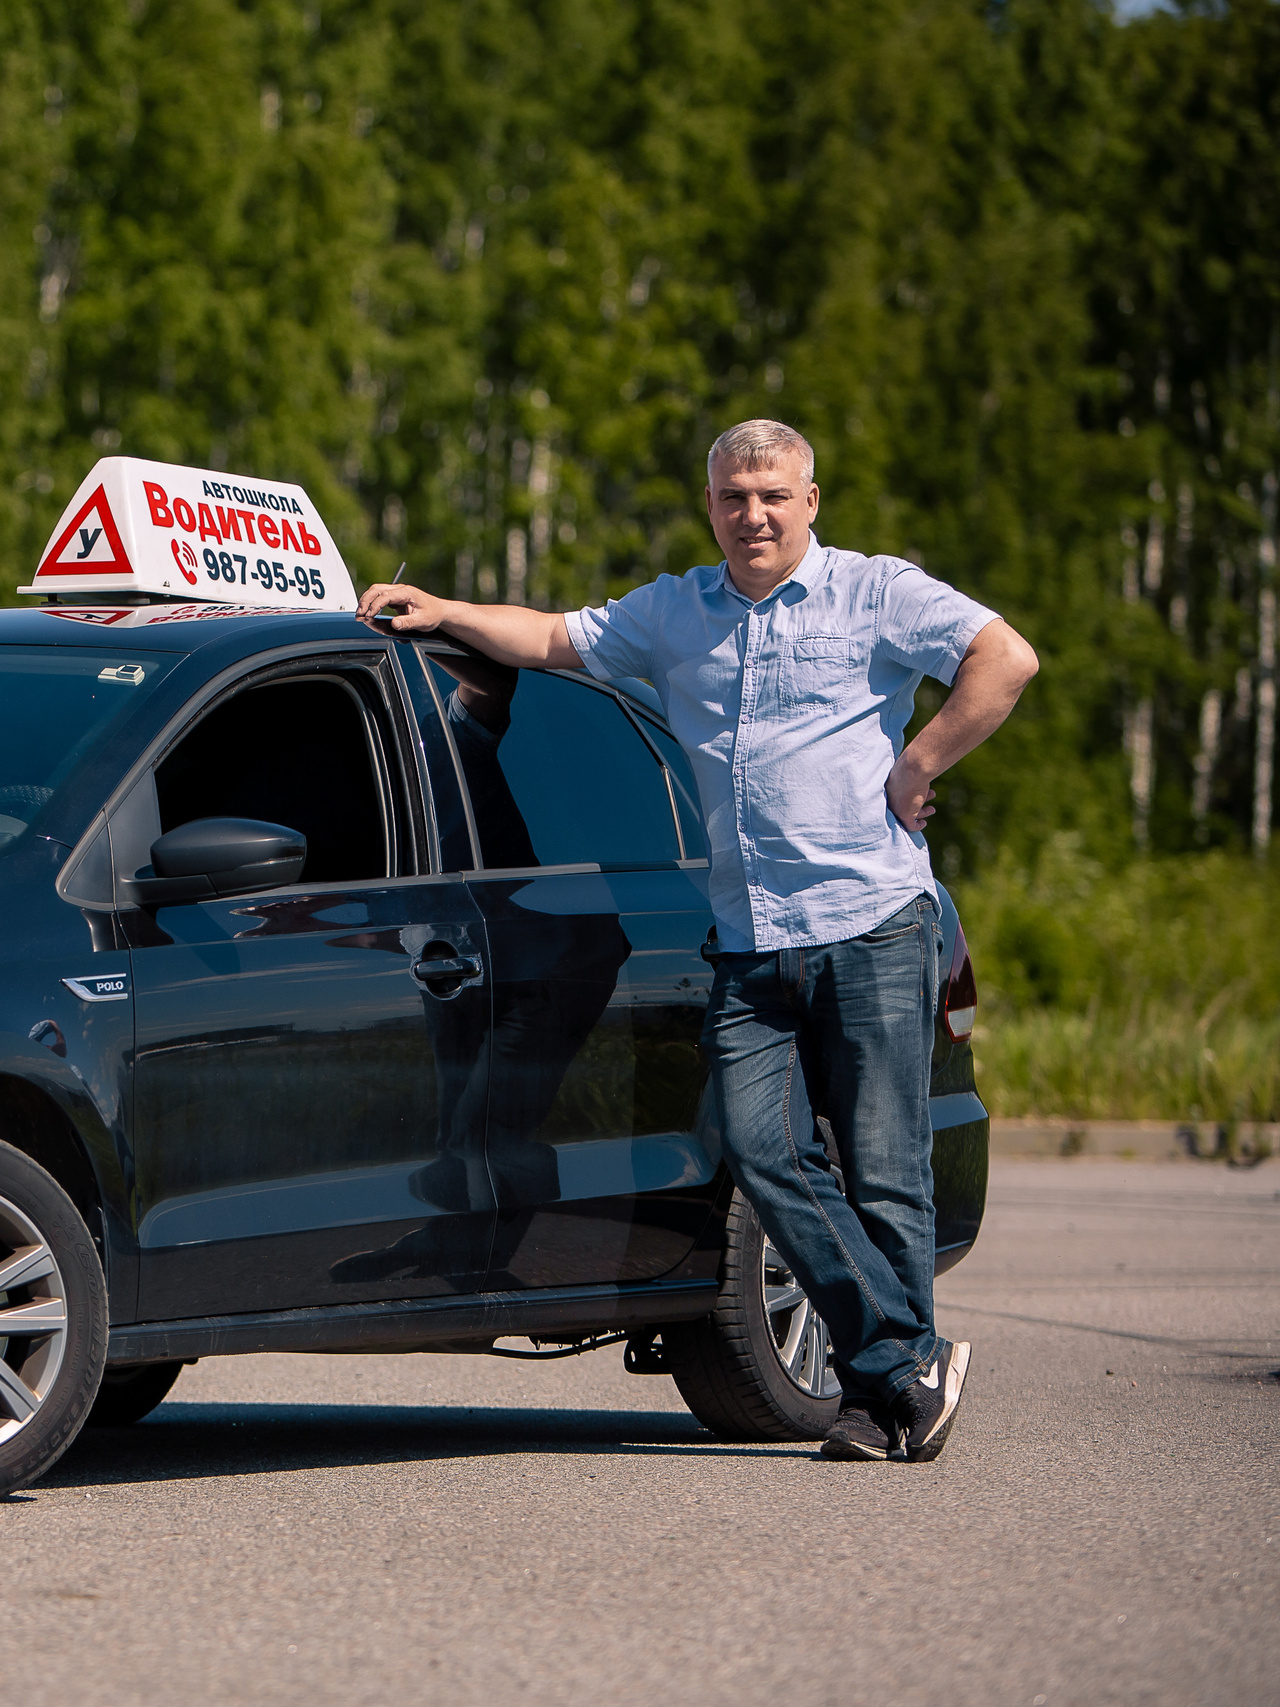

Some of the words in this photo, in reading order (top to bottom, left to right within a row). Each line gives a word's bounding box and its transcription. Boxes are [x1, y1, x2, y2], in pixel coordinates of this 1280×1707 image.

[142, 480, 322, 556] Водитель
[202, 480, 304, 516] АВТОШКОЛА
[203, 548, 326, 600] 987-95-95
[96, 981, 124, 992] POLO
